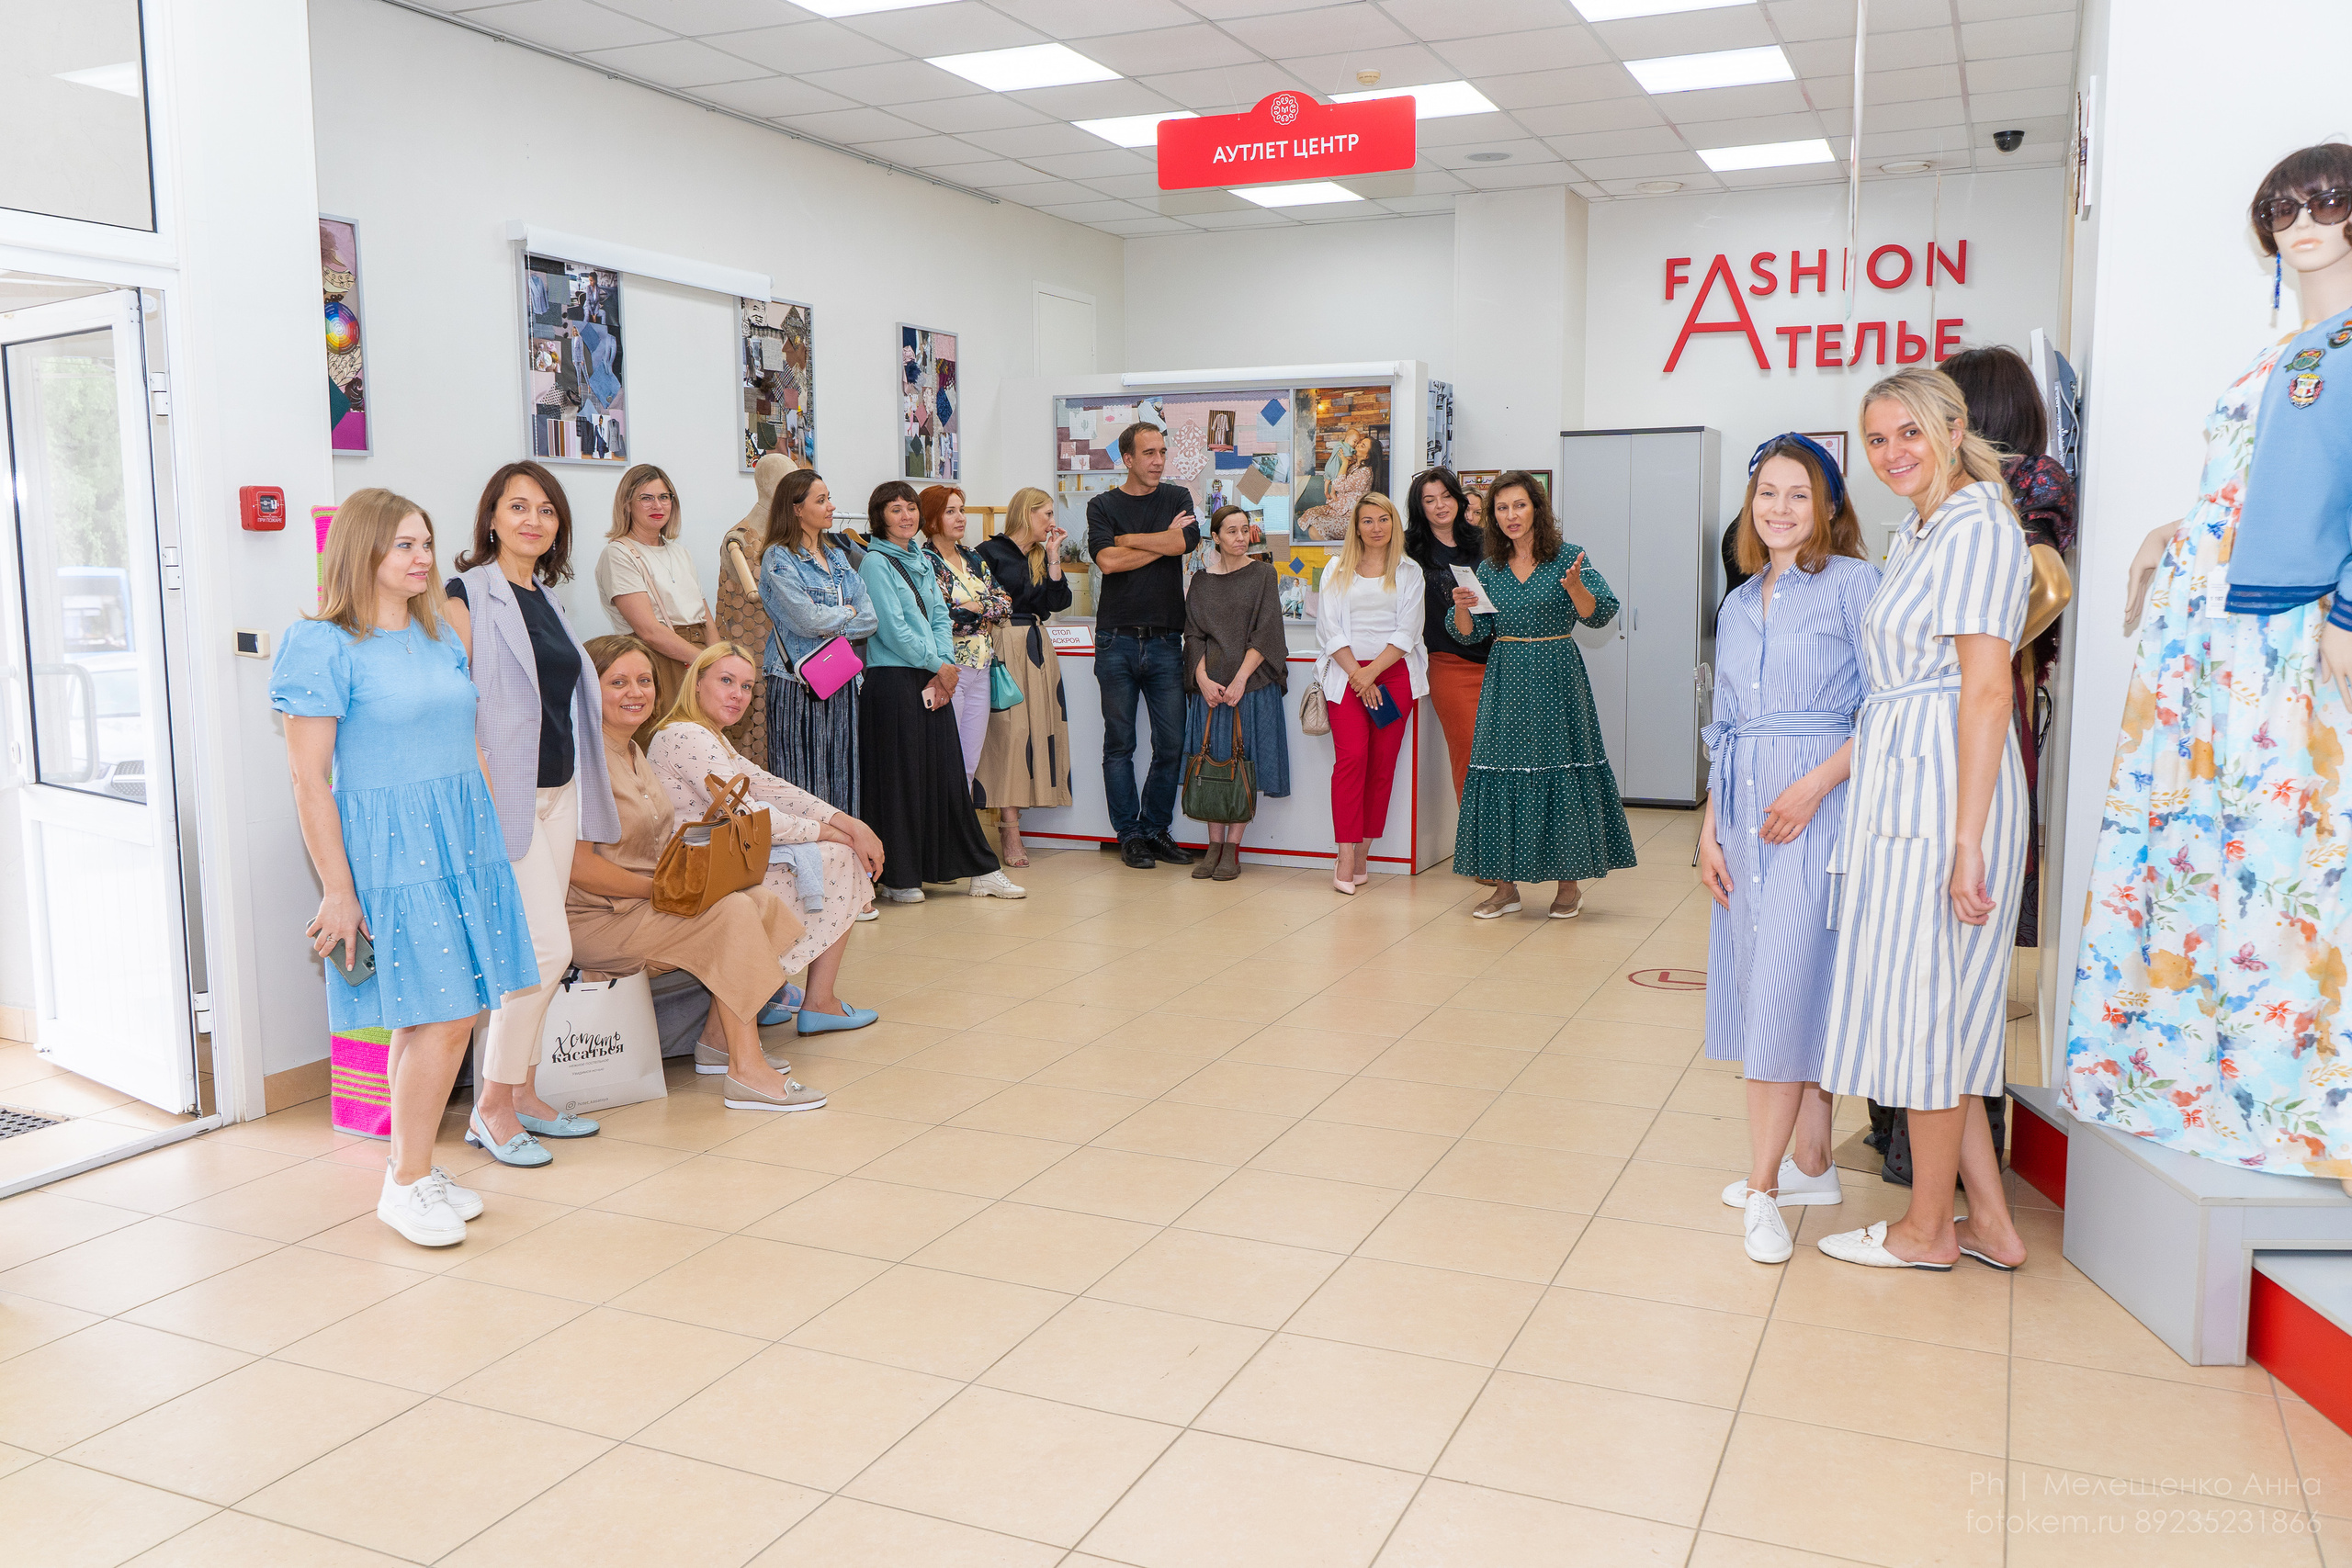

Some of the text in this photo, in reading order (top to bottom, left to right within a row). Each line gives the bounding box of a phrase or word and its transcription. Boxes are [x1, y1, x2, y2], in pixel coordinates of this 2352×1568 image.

[1213, 134, 1360, 164] АУТЛЕТ ЦЕНТР
[551, 1043, 624, 1064] касаться
